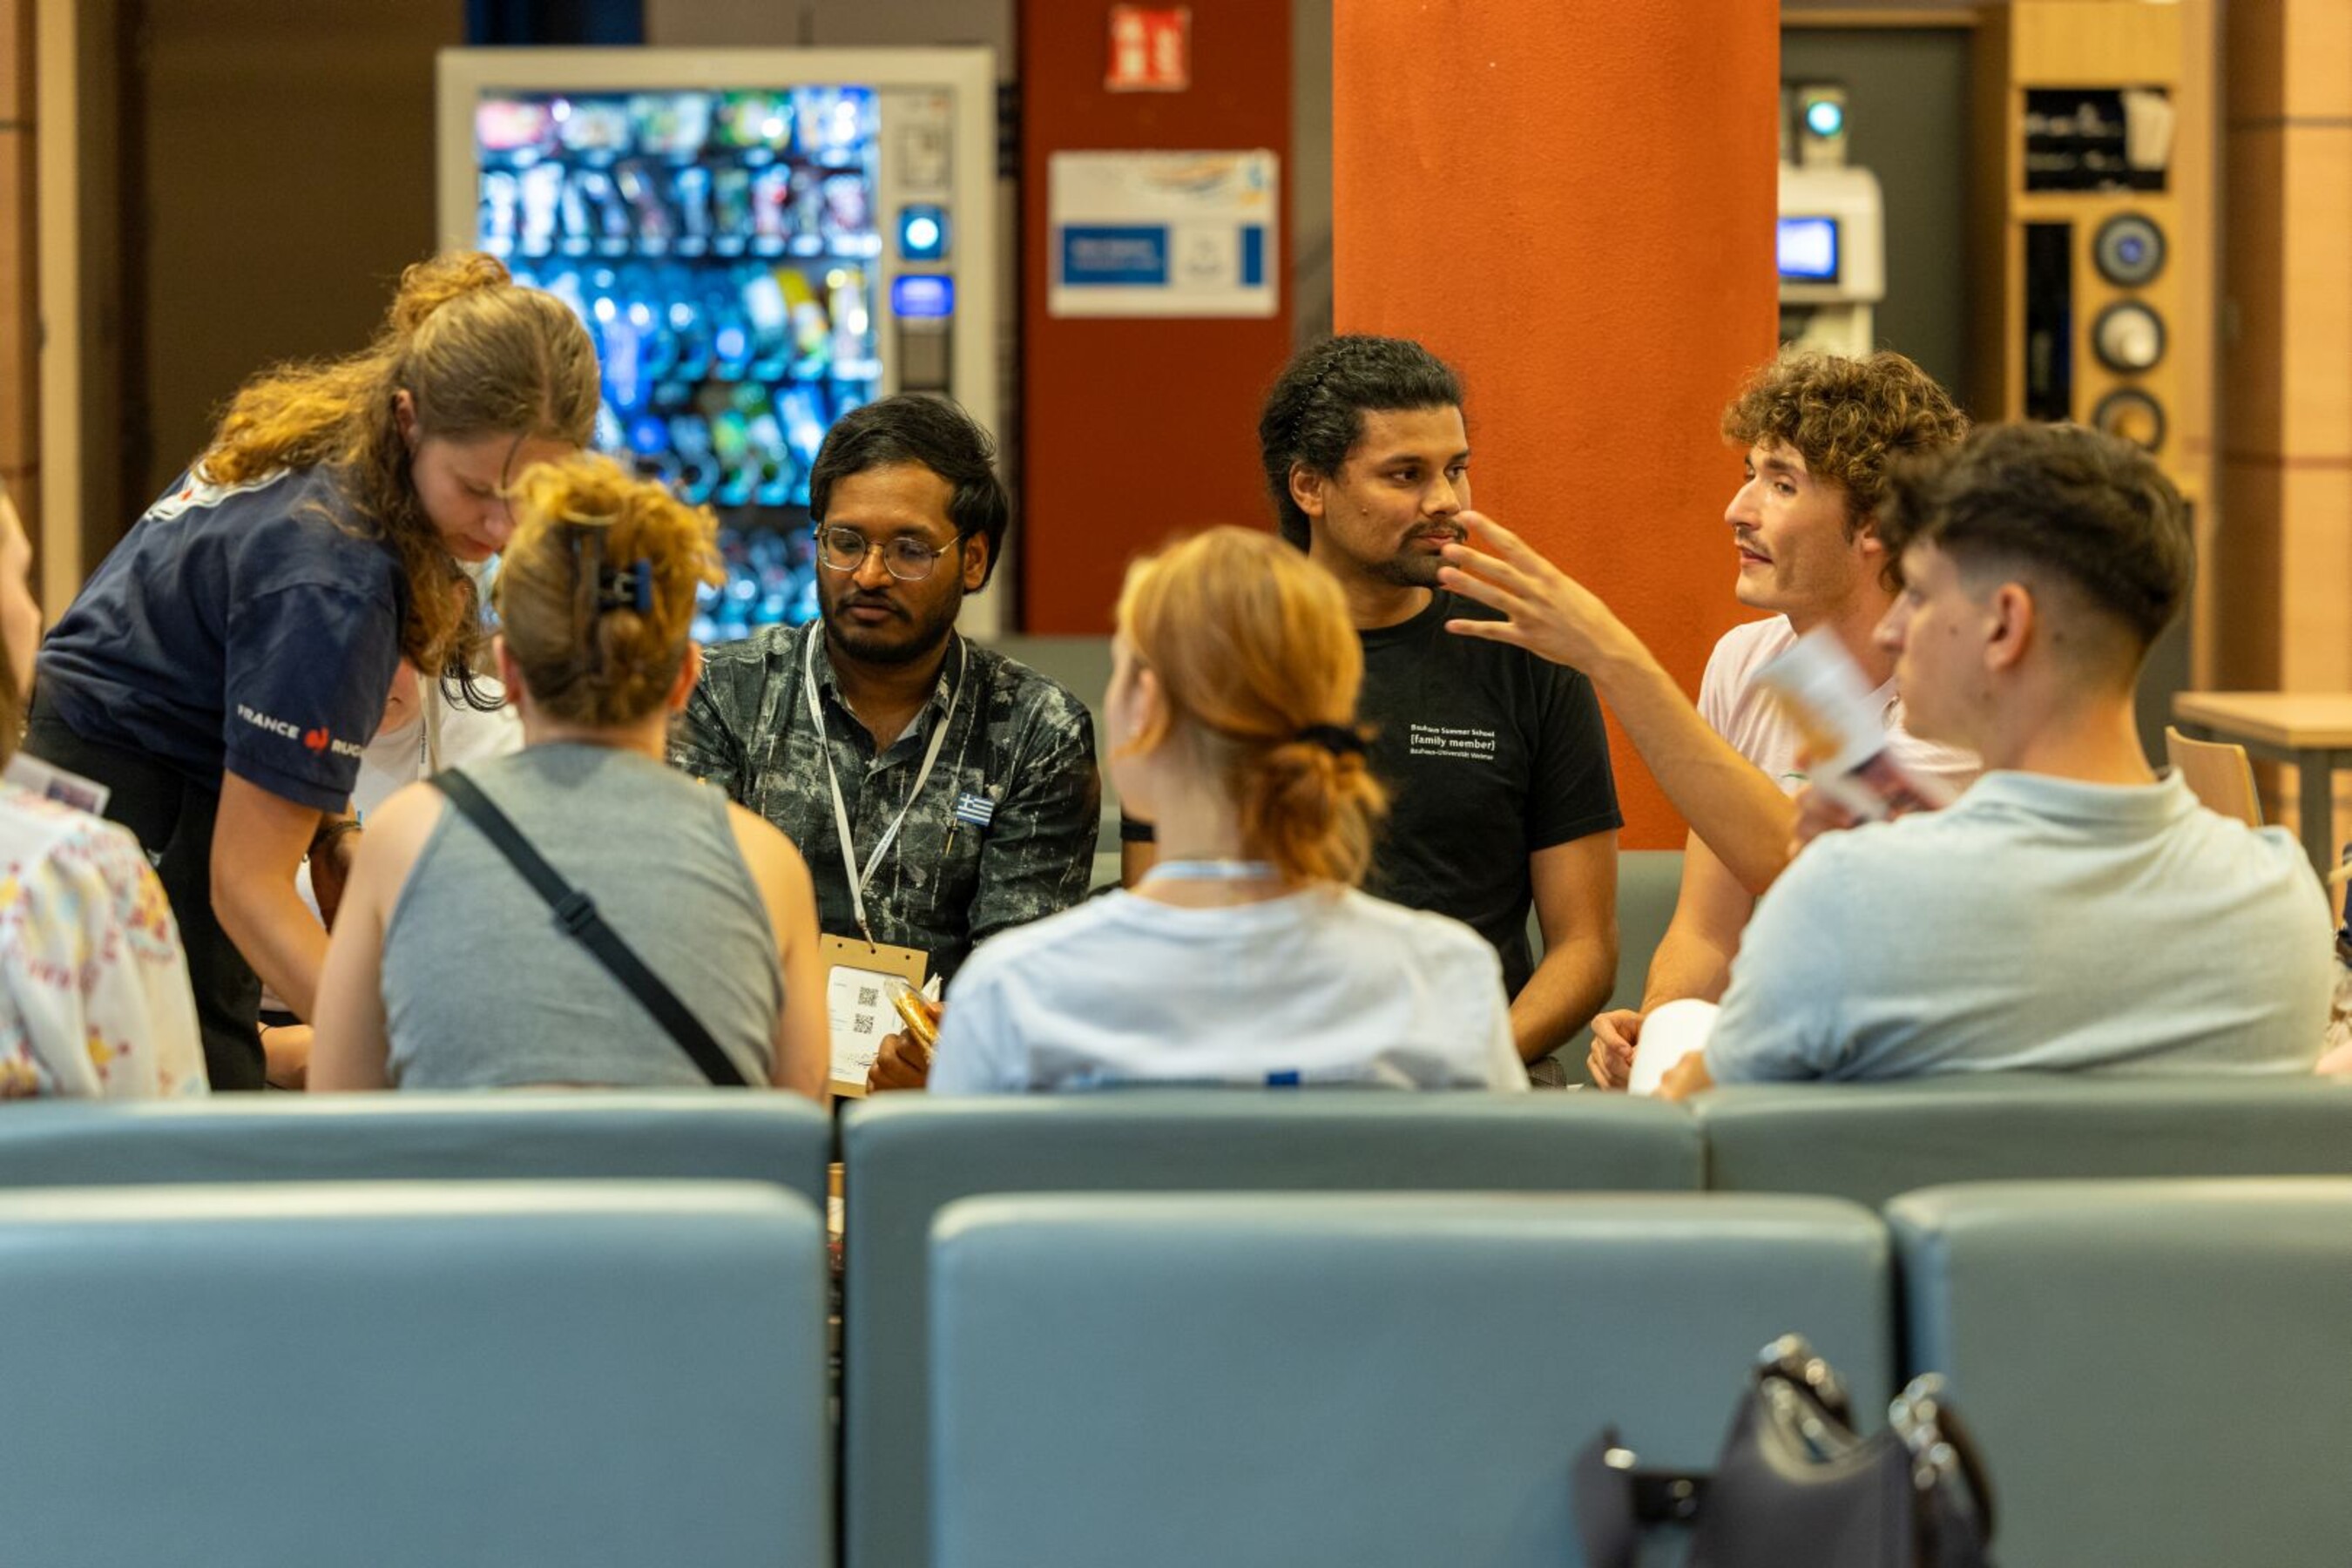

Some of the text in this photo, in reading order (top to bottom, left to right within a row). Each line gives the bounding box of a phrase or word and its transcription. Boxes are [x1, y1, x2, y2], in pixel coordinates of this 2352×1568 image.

[238, 704, 300, 739] FRANCE
[1410, 733, 1495, 752] [family member]
[1471, 729, 1495, 738] School
